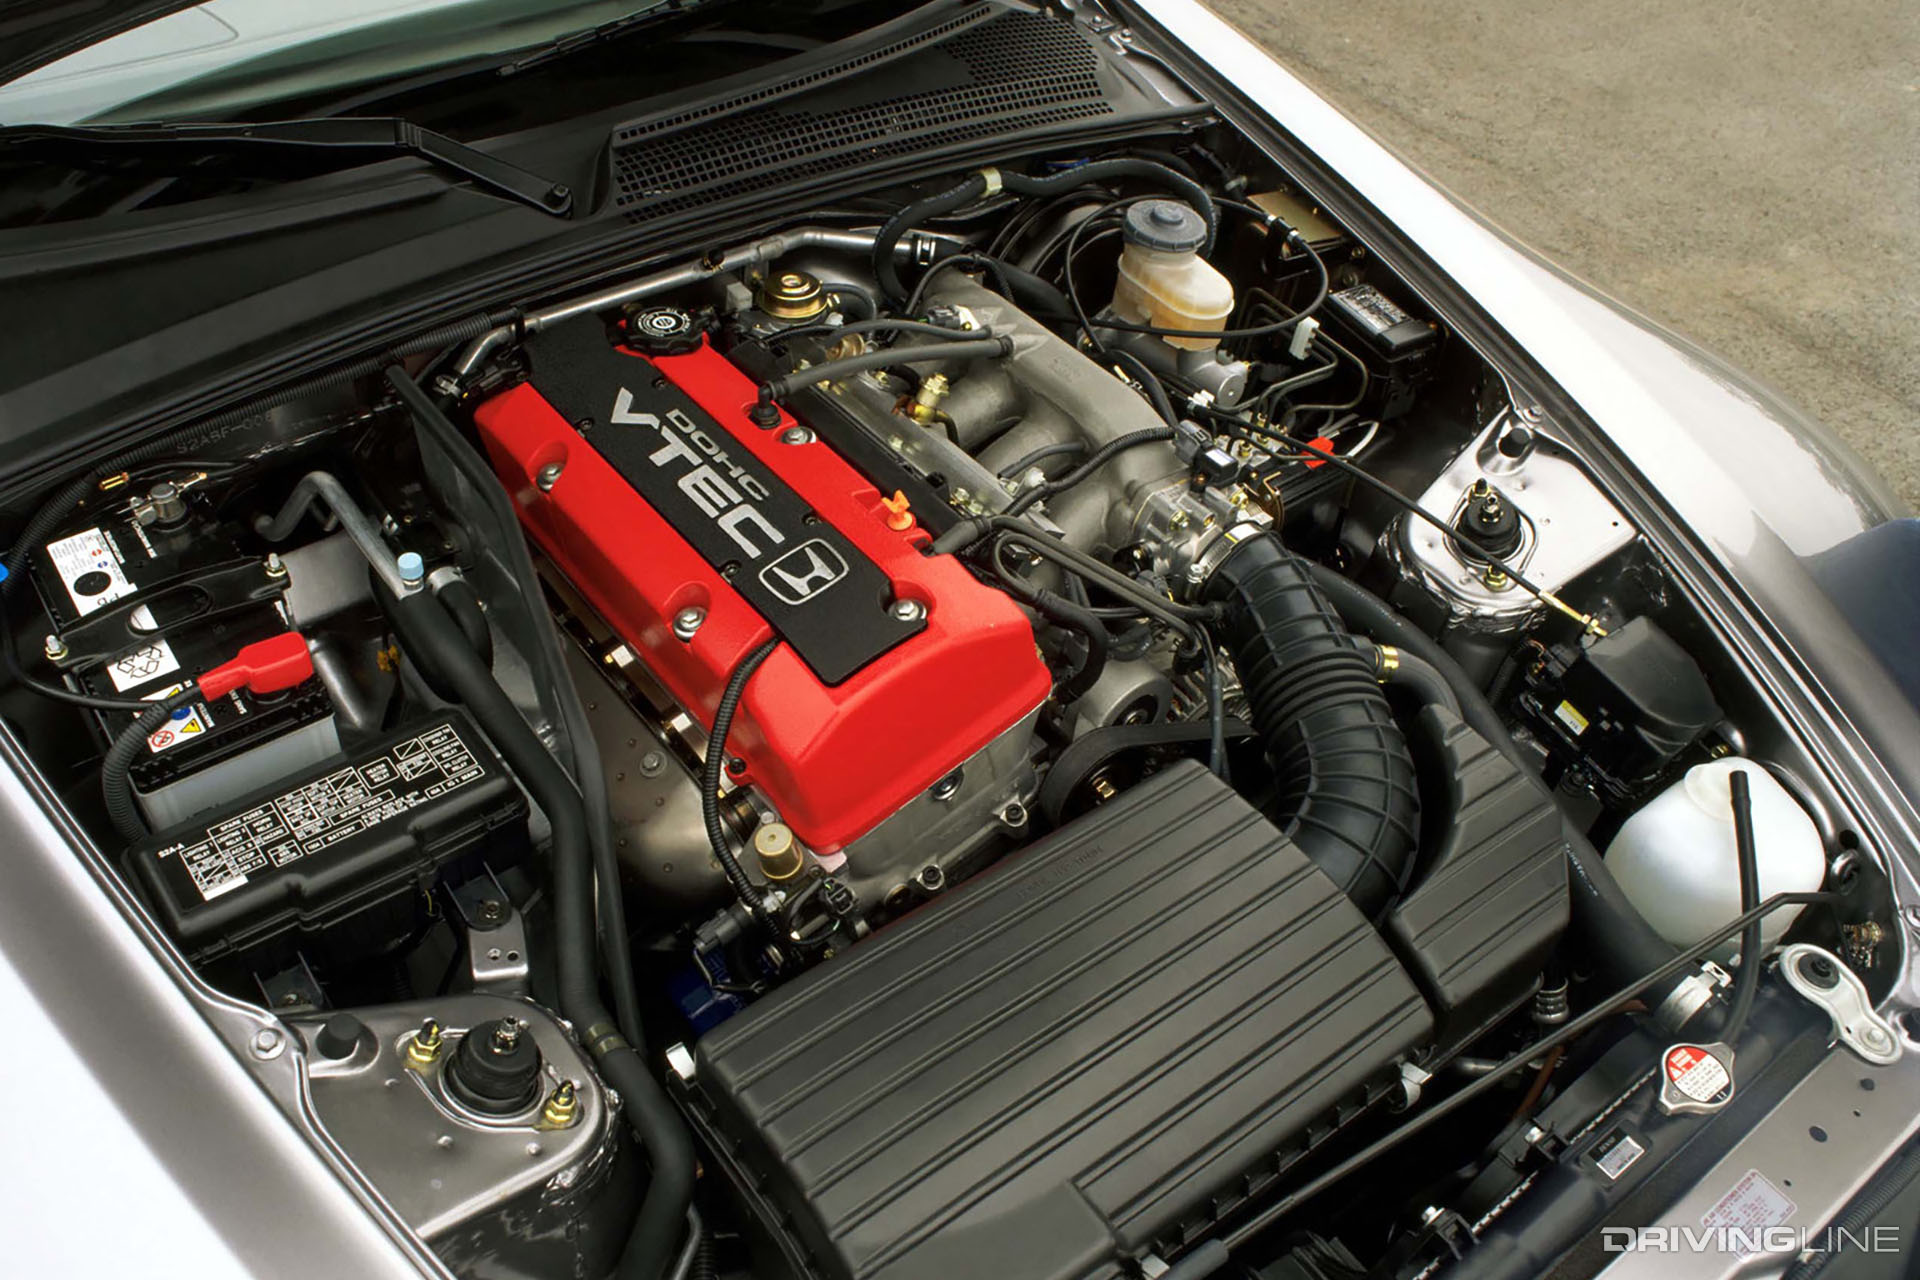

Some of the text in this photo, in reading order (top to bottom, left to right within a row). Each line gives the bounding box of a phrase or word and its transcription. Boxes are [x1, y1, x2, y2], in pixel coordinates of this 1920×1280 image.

[666, 408, 769, 500] DOHC
[611, 387, 785, 559] VTEC
[219, 809, 264, 831] SPARE FUSES
[326, 825, 356, 841] BATTERY
[236, 851, 256, 862] STOP
